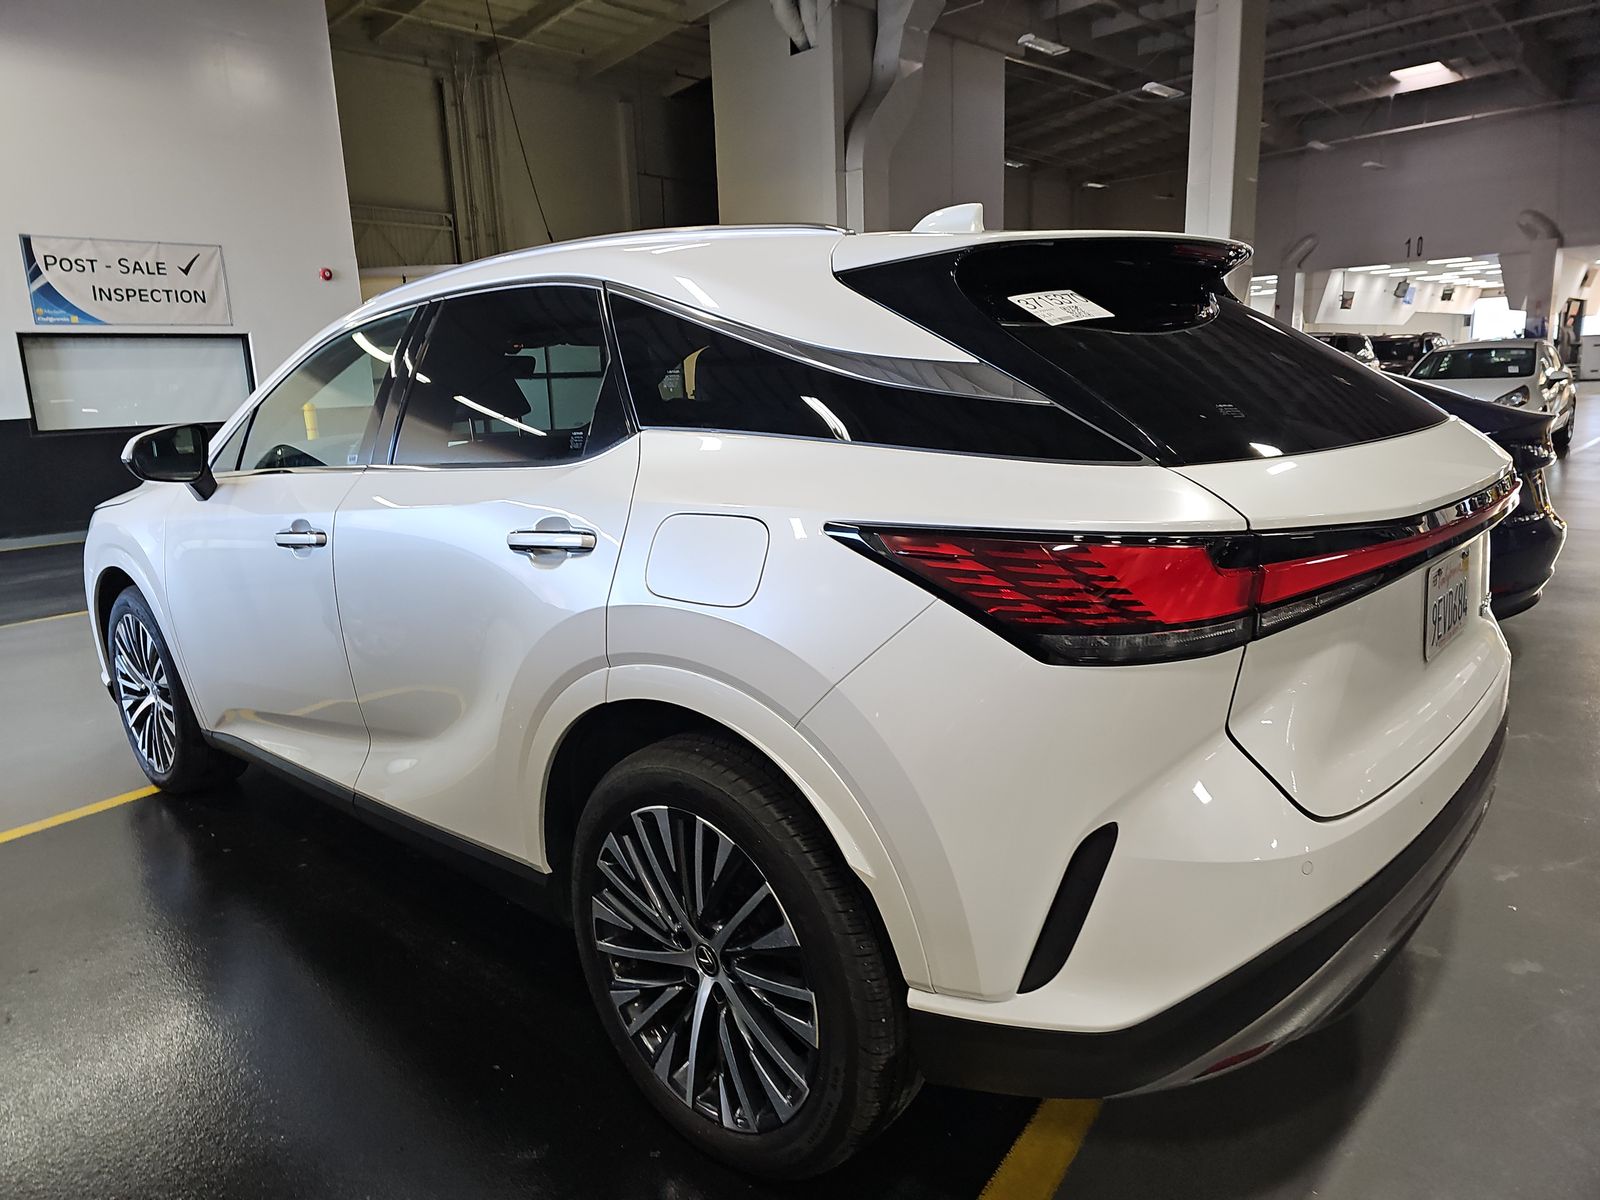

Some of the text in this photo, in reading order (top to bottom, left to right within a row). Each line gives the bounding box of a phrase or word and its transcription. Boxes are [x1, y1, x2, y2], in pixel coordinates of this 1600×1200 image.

[1405, 236, 1423, 258] 10
[43, 255, 98, 273] POST
[118, 258, 168, 276] SALE
[92, 285, 207, 304] INSPECTION
[1432, 577, 1467, 646] 9EVD684
